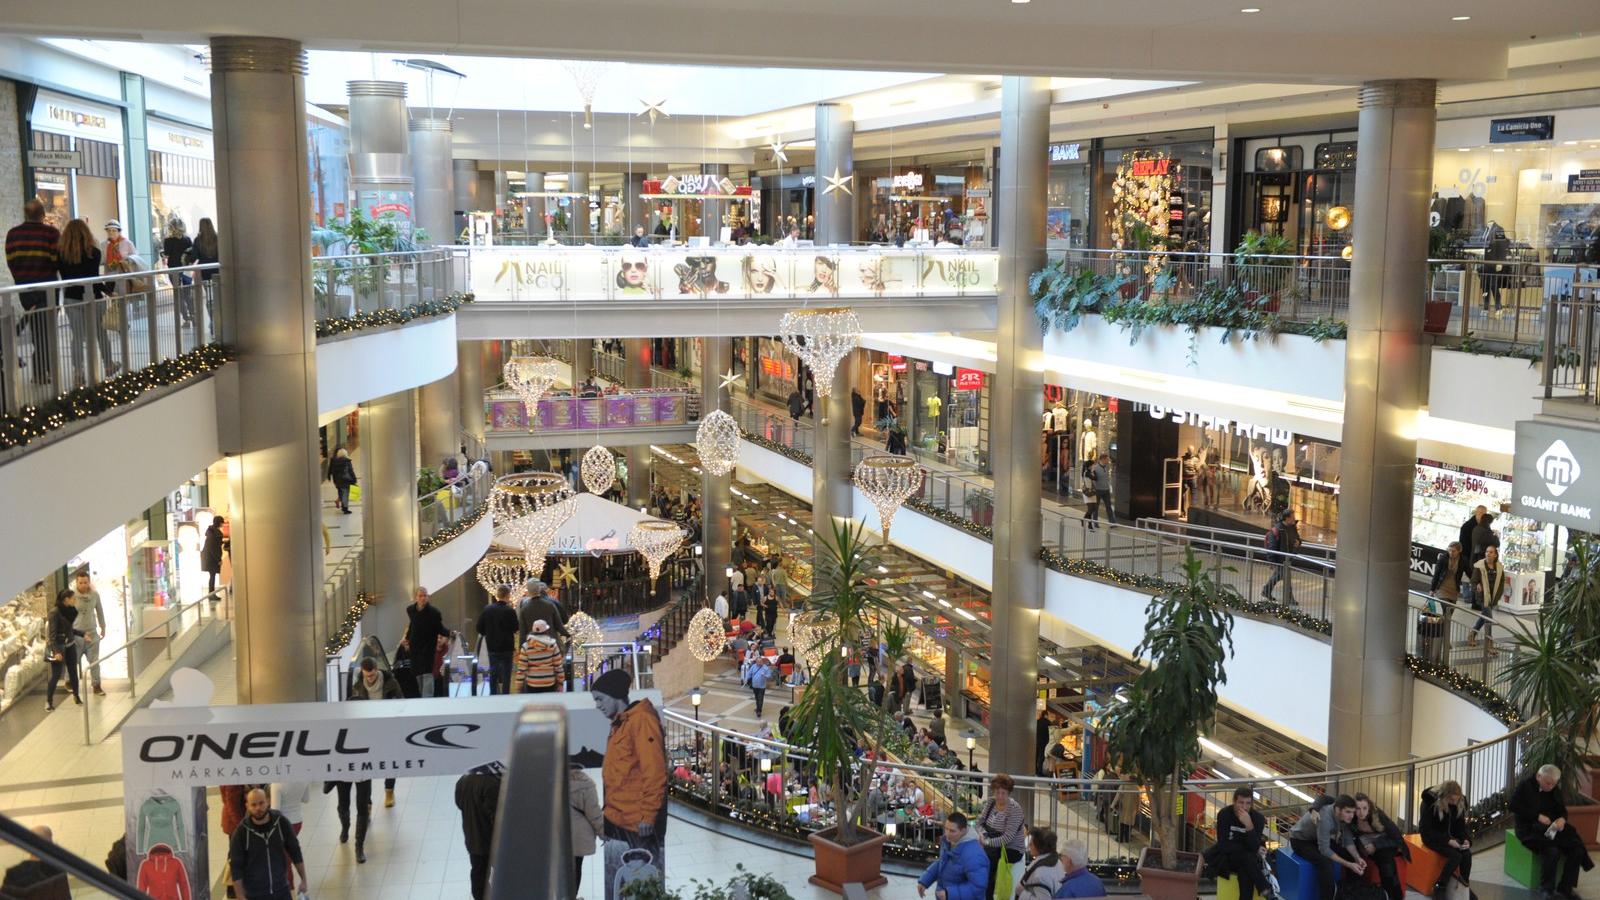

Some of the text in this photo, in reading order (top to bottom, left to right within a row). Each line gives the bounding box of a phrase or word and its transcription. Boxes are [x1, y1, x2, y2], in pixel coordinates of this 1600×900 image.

[1052, 143, 1079, 160] BANK
[1133, 159, 1169, 176] REPLAY
[525, 261, 562, 275] NAIL
[947, 260, 980, 273] NAIL
[1521, 495, 1592, 520] GRÁNIT BANK
[139, 728, 370, 763] O'NEILL
[171, 764, 292, 780] MÁRKABOLT
